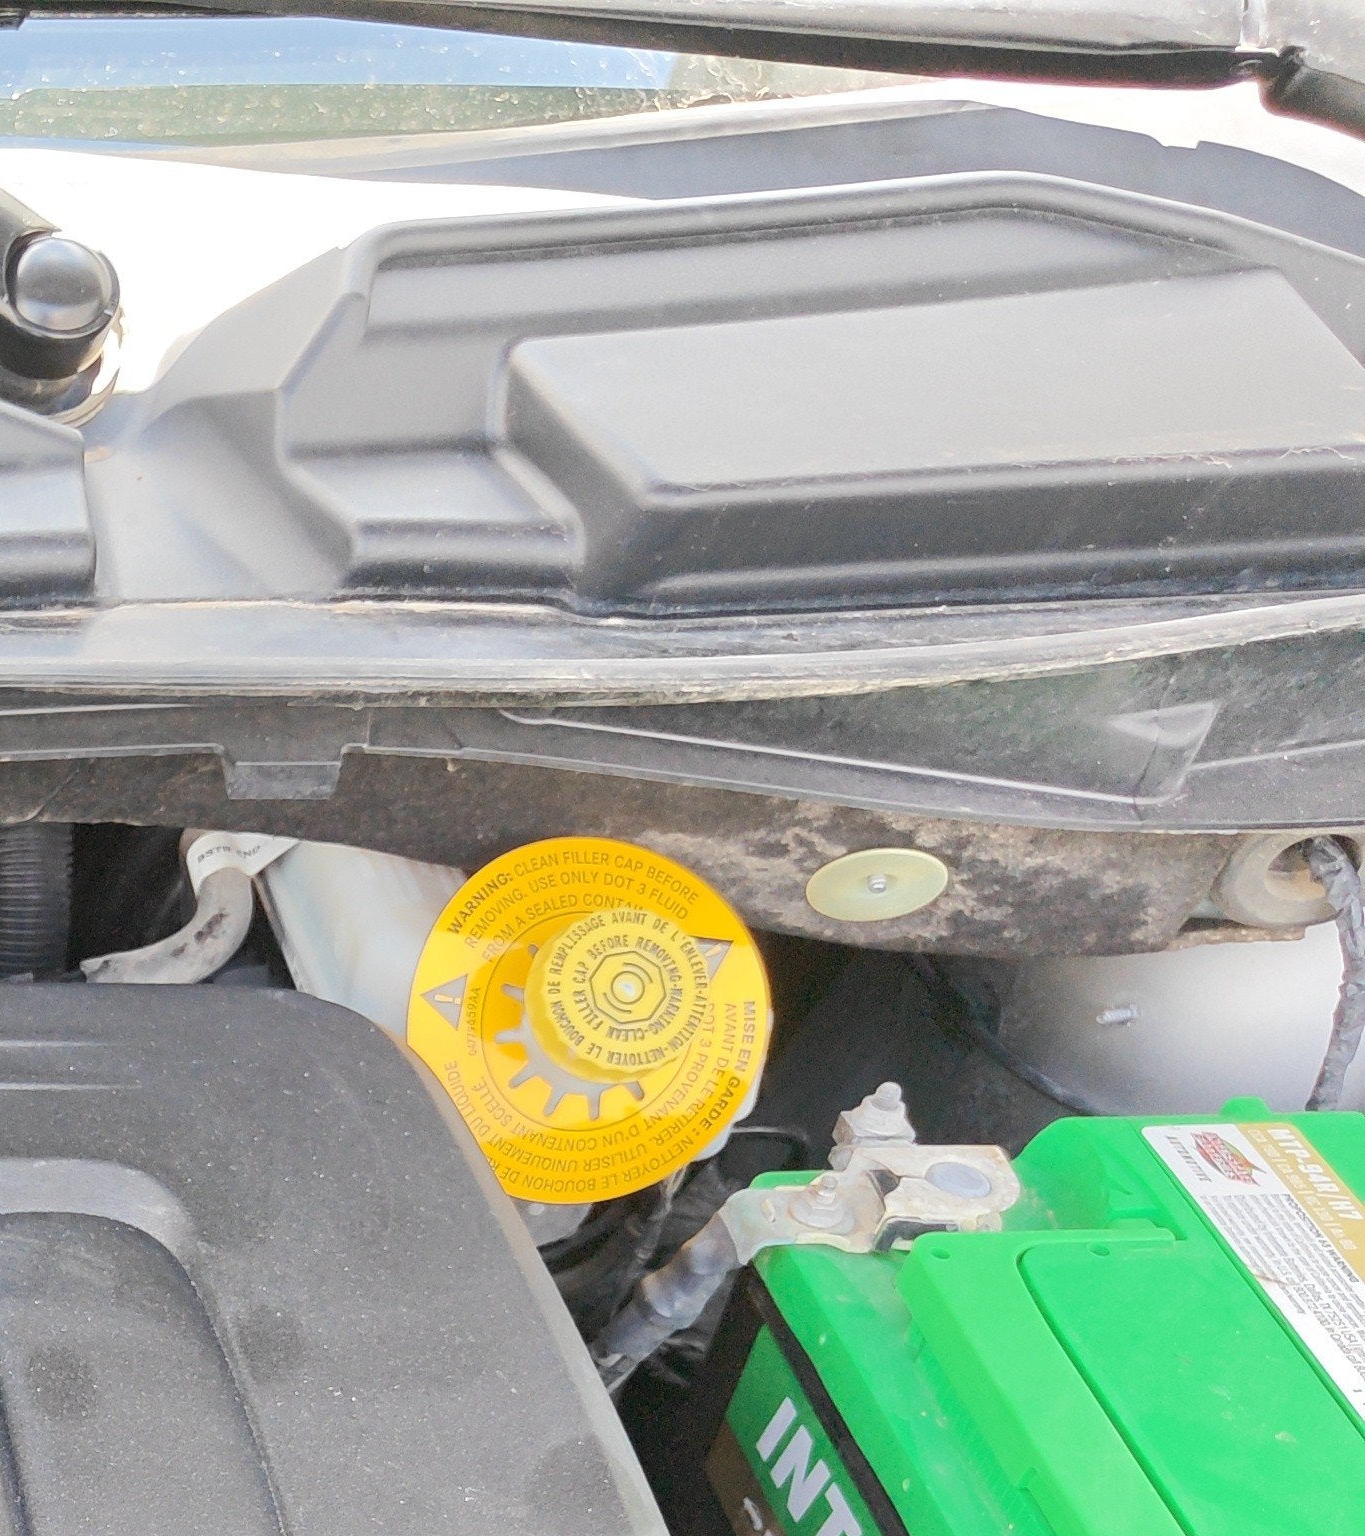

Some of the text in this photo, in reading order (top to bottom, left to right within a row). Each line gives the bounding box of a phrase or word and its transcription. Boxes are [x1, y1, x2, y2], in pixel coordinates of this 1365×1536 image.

[447, 849, 699, 935] WARNING: CLEAN FILLER CAP BEFORE
[465, 870, 688, 949] REMOVING. USE ONLY DOT 3 FLUID
[611, 911, 648, 925] AVANT
[482, 924, 515, 962] FROM
[515, 916, 527, 929] A
[525, 894, 578, 919] SEALED
[652, 918, 669, 934] DE
[547, 911, 606, 976] REMPLISSAGE
[584, 931, 629, 960] BEFORE
[571, 959, 590, 983] CAP
[547, 980, 561, 995] DE
[570, 989, 604, 1032] FILLER
[742, 1001, 756, 1044] MISE
[718, 1001, 737, 1055] AVANT
[585, 1041, 603, 1059] LE
[699, 1038, 712, 1048] 3
[712, 1056, 729, 1078] DE
[735, 1049, 751, 1072] EN
[444, 1060, 476, 1118] LIQUIDE
[643, 1052, 708, 1130] PROVENANT
[699, 1076, 741, 1129] GARDE
[700, 1080, 719, 1098] LE
[469, 1116, 490, 1137] DU
[601, 1123, 640, 1147] D'UN
[649, 1099, 705, 1146] RETIRER.
[510, 1122, 597, 1152] CONTENANT
[487, 1133, 577, 1172] UNIQUEMENT
[584, 1143, 648, 1170] UTILISER
[623, 1136, 694, 1182] NETTOYER
[499, 1165, 520, 1184] DE
[522, 1174, 596, 1193] BOUCHON
[600, 1175, 618, 1189] LE
